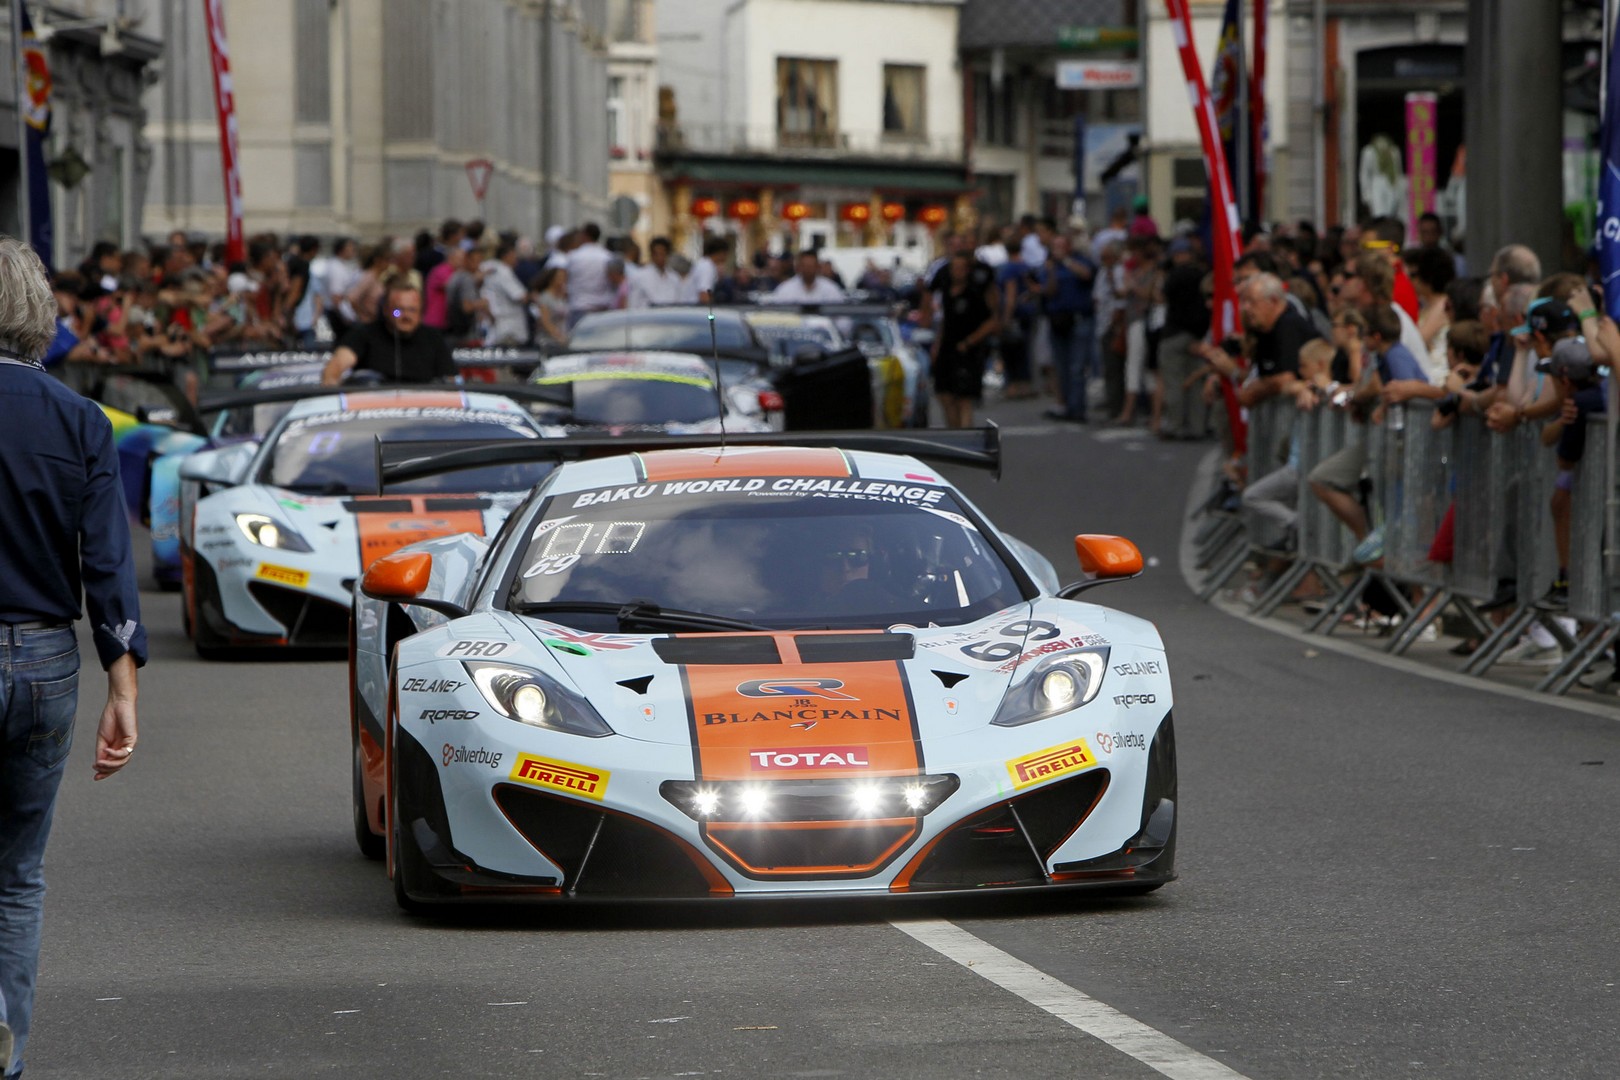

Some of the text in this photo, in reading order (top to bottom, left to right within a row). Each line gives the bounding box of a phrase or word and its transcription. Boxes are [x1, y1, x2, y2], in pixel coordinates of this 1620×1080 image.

[572, 478, 945, 509] BAKU WORLD CHALLENGE
[523, 554, 581, 578] 69
[446, 641, 508, 657] PRO
[960, 619, 1061, 662] 69
[1113, 661, 1163, 676] DELANEY
[402, 678, 467, 693] DELANEY
[702, 708, 900, 726] BLANCPAIN
[1113, 731, 1146, 751] silverbug
[454, 745, 502, 768] silverbug
[750, 751, 868, 767] TOTAL
[1015, 745, 1088, 783] PIRELLI
[518, 759, 600, 793] PIRELLI
